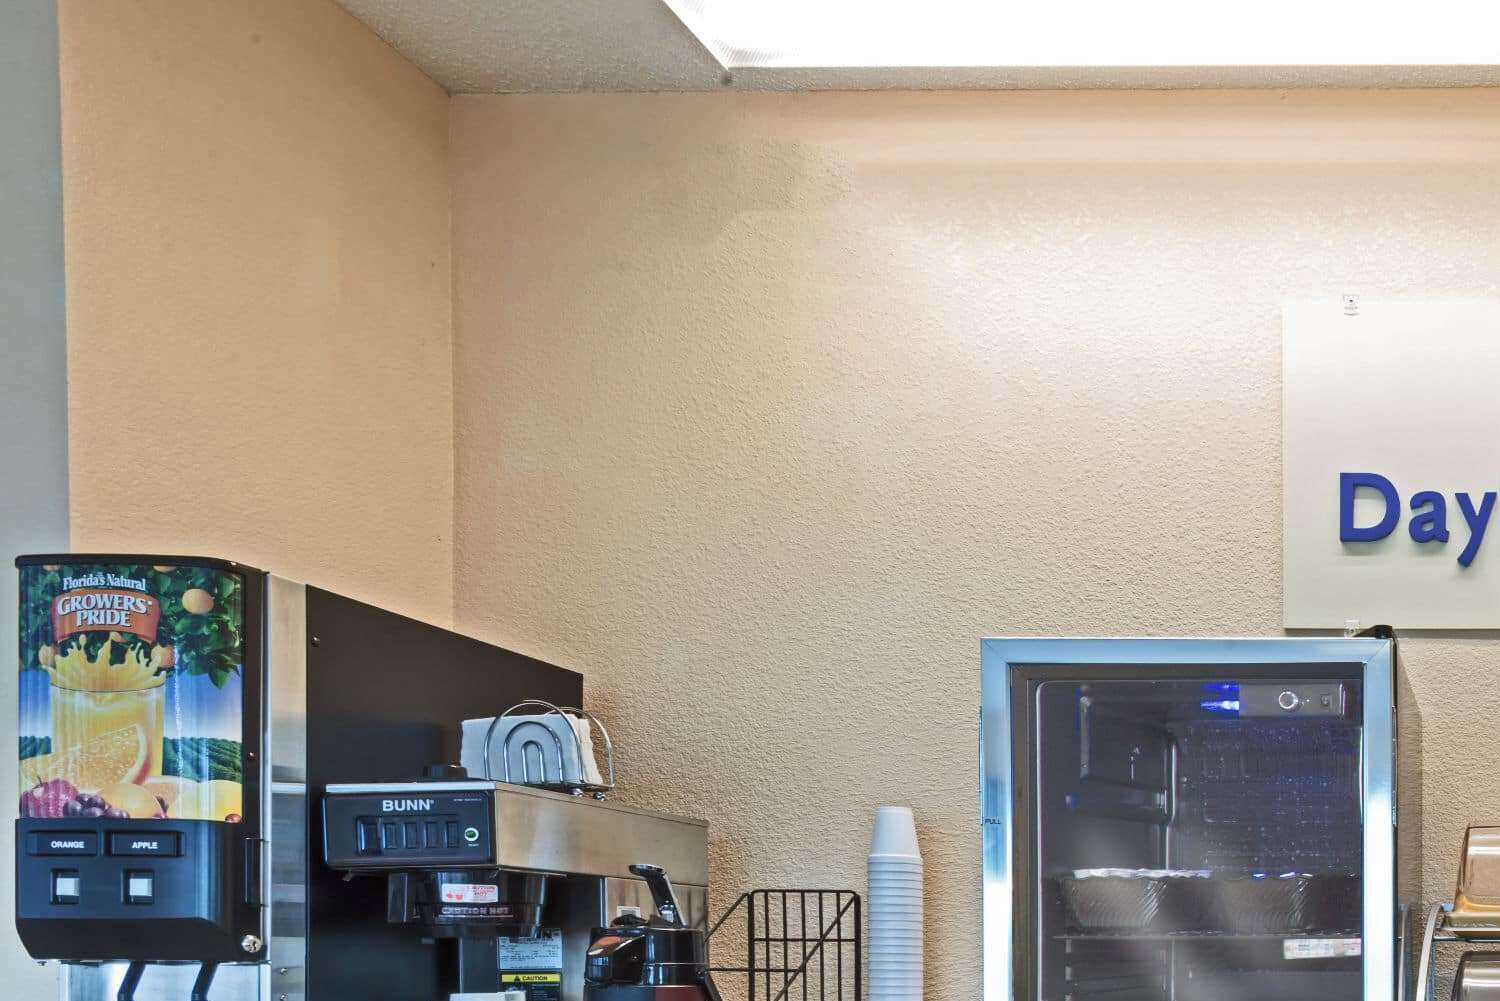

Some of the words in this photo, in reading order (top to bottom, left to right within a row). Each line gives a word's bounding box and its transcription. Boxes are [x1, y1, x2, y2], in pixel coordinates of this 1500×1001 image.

[63, 573, 105, 590] Florida's
[107, 573, 146, 591] Natural
[76, 610, 131, 627] PRIDE
[382, 799, 431, 812] BUNN
[51, 840, 85, 849] ORANGE
[132, 841, 158, 850] APPLE
